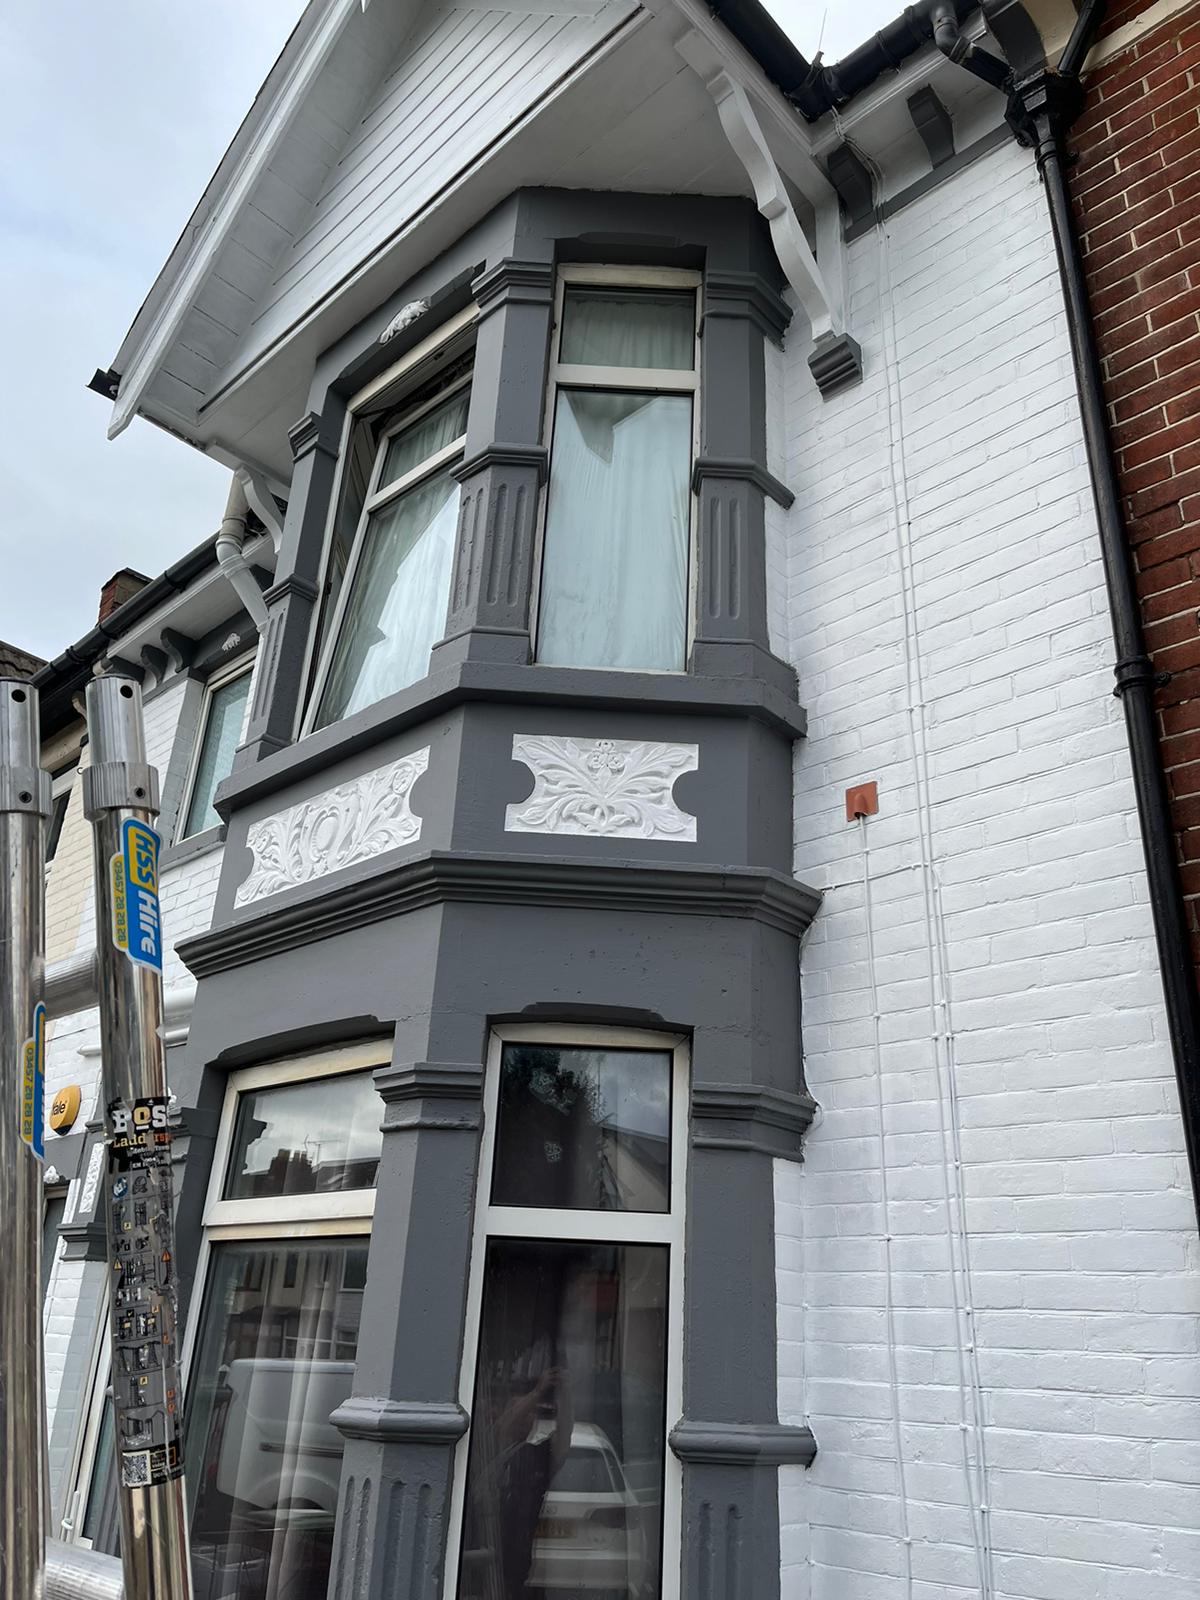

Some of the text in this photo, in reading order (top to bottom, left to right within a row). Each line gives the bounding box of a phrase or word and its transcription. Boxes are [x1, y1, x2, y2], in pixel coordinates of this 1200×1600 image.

[114, 860, 126, 942] 03457 28 28 28
[135, 833, 157, 956] HSS Hire
[25, 1086, 32, 1100] 28
[25, 1103, 32, 1117] 28
[24, 1120, 32, 1135] 28
